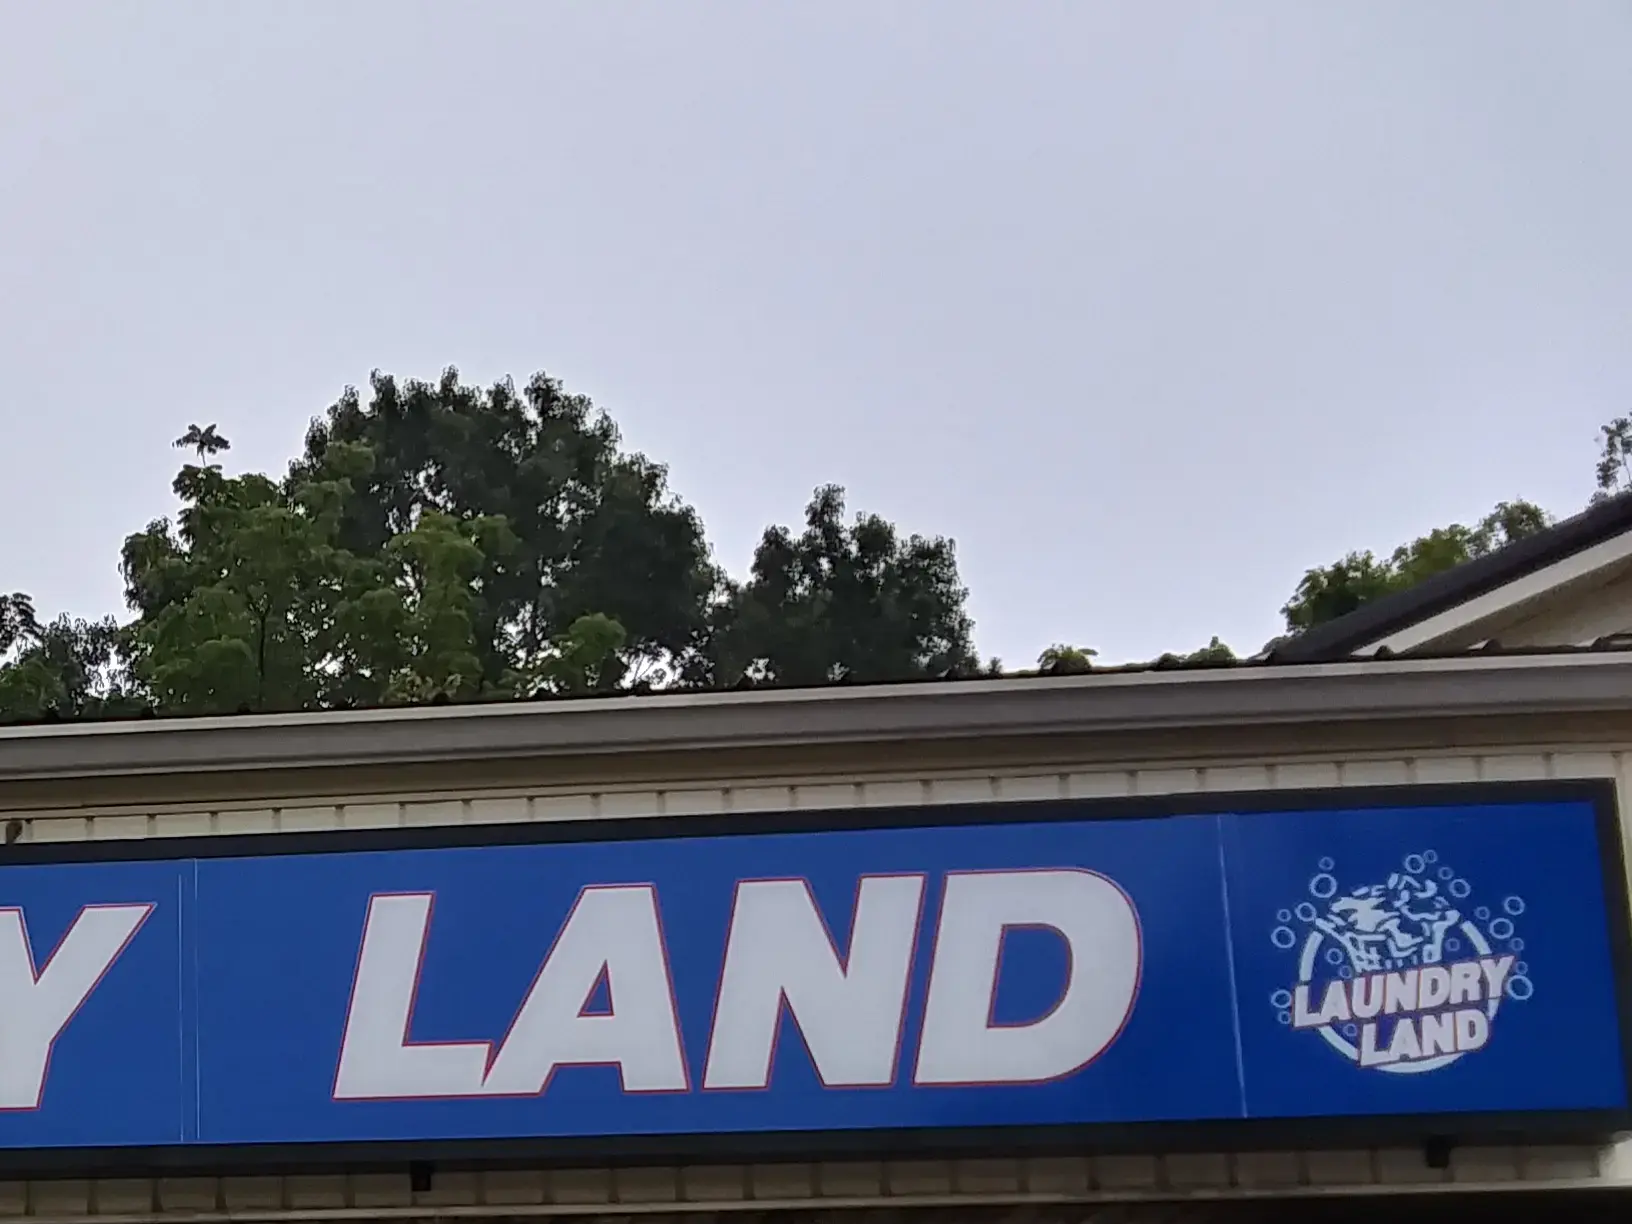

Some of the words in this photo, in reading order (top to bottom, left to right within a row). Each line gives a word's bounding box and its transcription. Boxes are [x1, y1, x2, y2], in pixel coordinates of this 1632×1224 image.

[332, 868, 1144, 1100] LAND
[1292, 955, 1515, 1029] LAUNDRY
[1358, 1009, 1490, 1067] LAND
